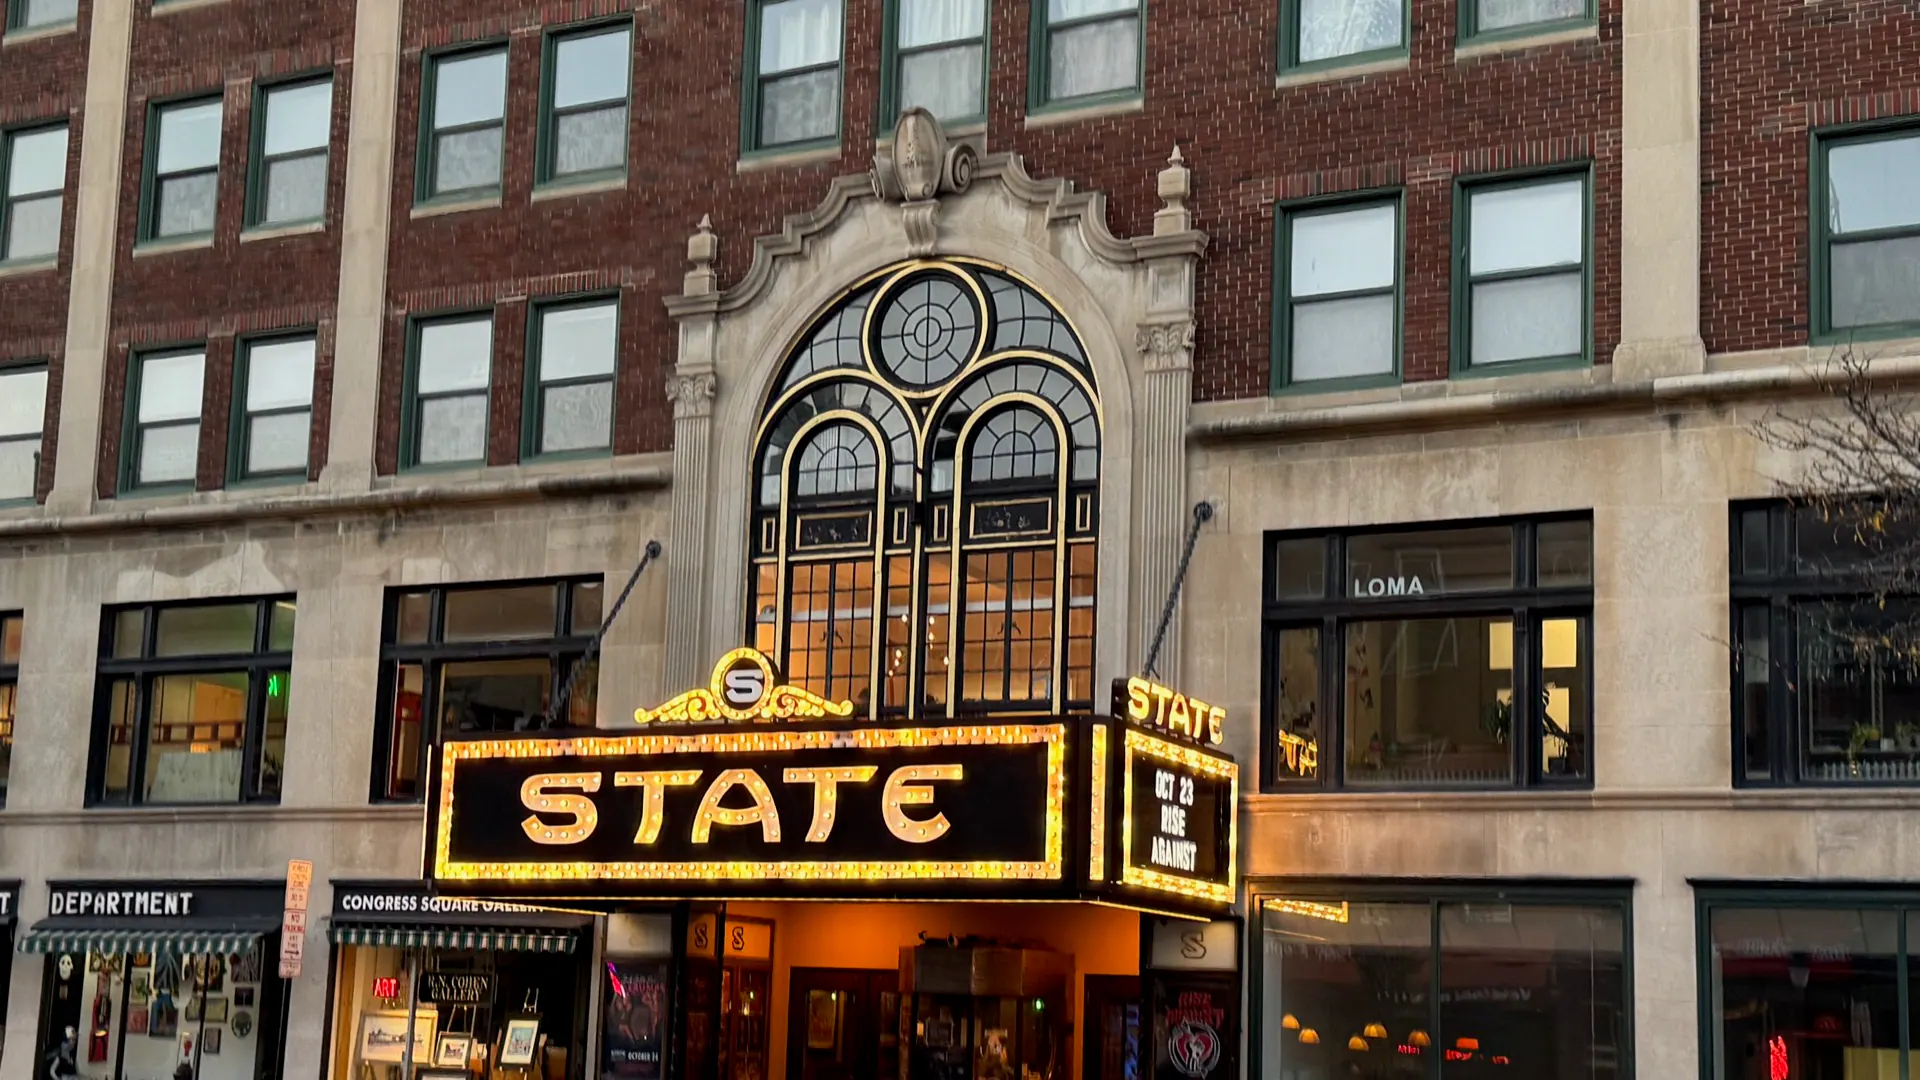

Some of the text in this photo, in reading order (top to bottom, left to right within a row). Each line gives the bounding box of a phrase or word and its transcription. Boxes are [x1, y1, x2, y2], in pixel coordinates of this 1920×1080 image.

[1355, 575, 1424, 597] LOMA
[725, 668, 763, 703] S
[1127, 676, 1226, 745] STATE
[1155, 768, 1194, 807] OCT 23
[520, 763, 963, 845] STATE
[1161, 804, 1186, 837] RISE
[1151, 836, 1197, 872] AGAINST
[51, 891, 193, 916] DEPARTMENT
[342, 895, 417, 911] CONGRESS
[421, 896, 479, 914] SQUARE
[732, 926, 745, 950] S
[1180, 930, 1207, 959] S
[374, 978, 397, 997] ART
[431, 986, 481, 1001] GALLERY
[452, 975, 488, 989] COHEN
